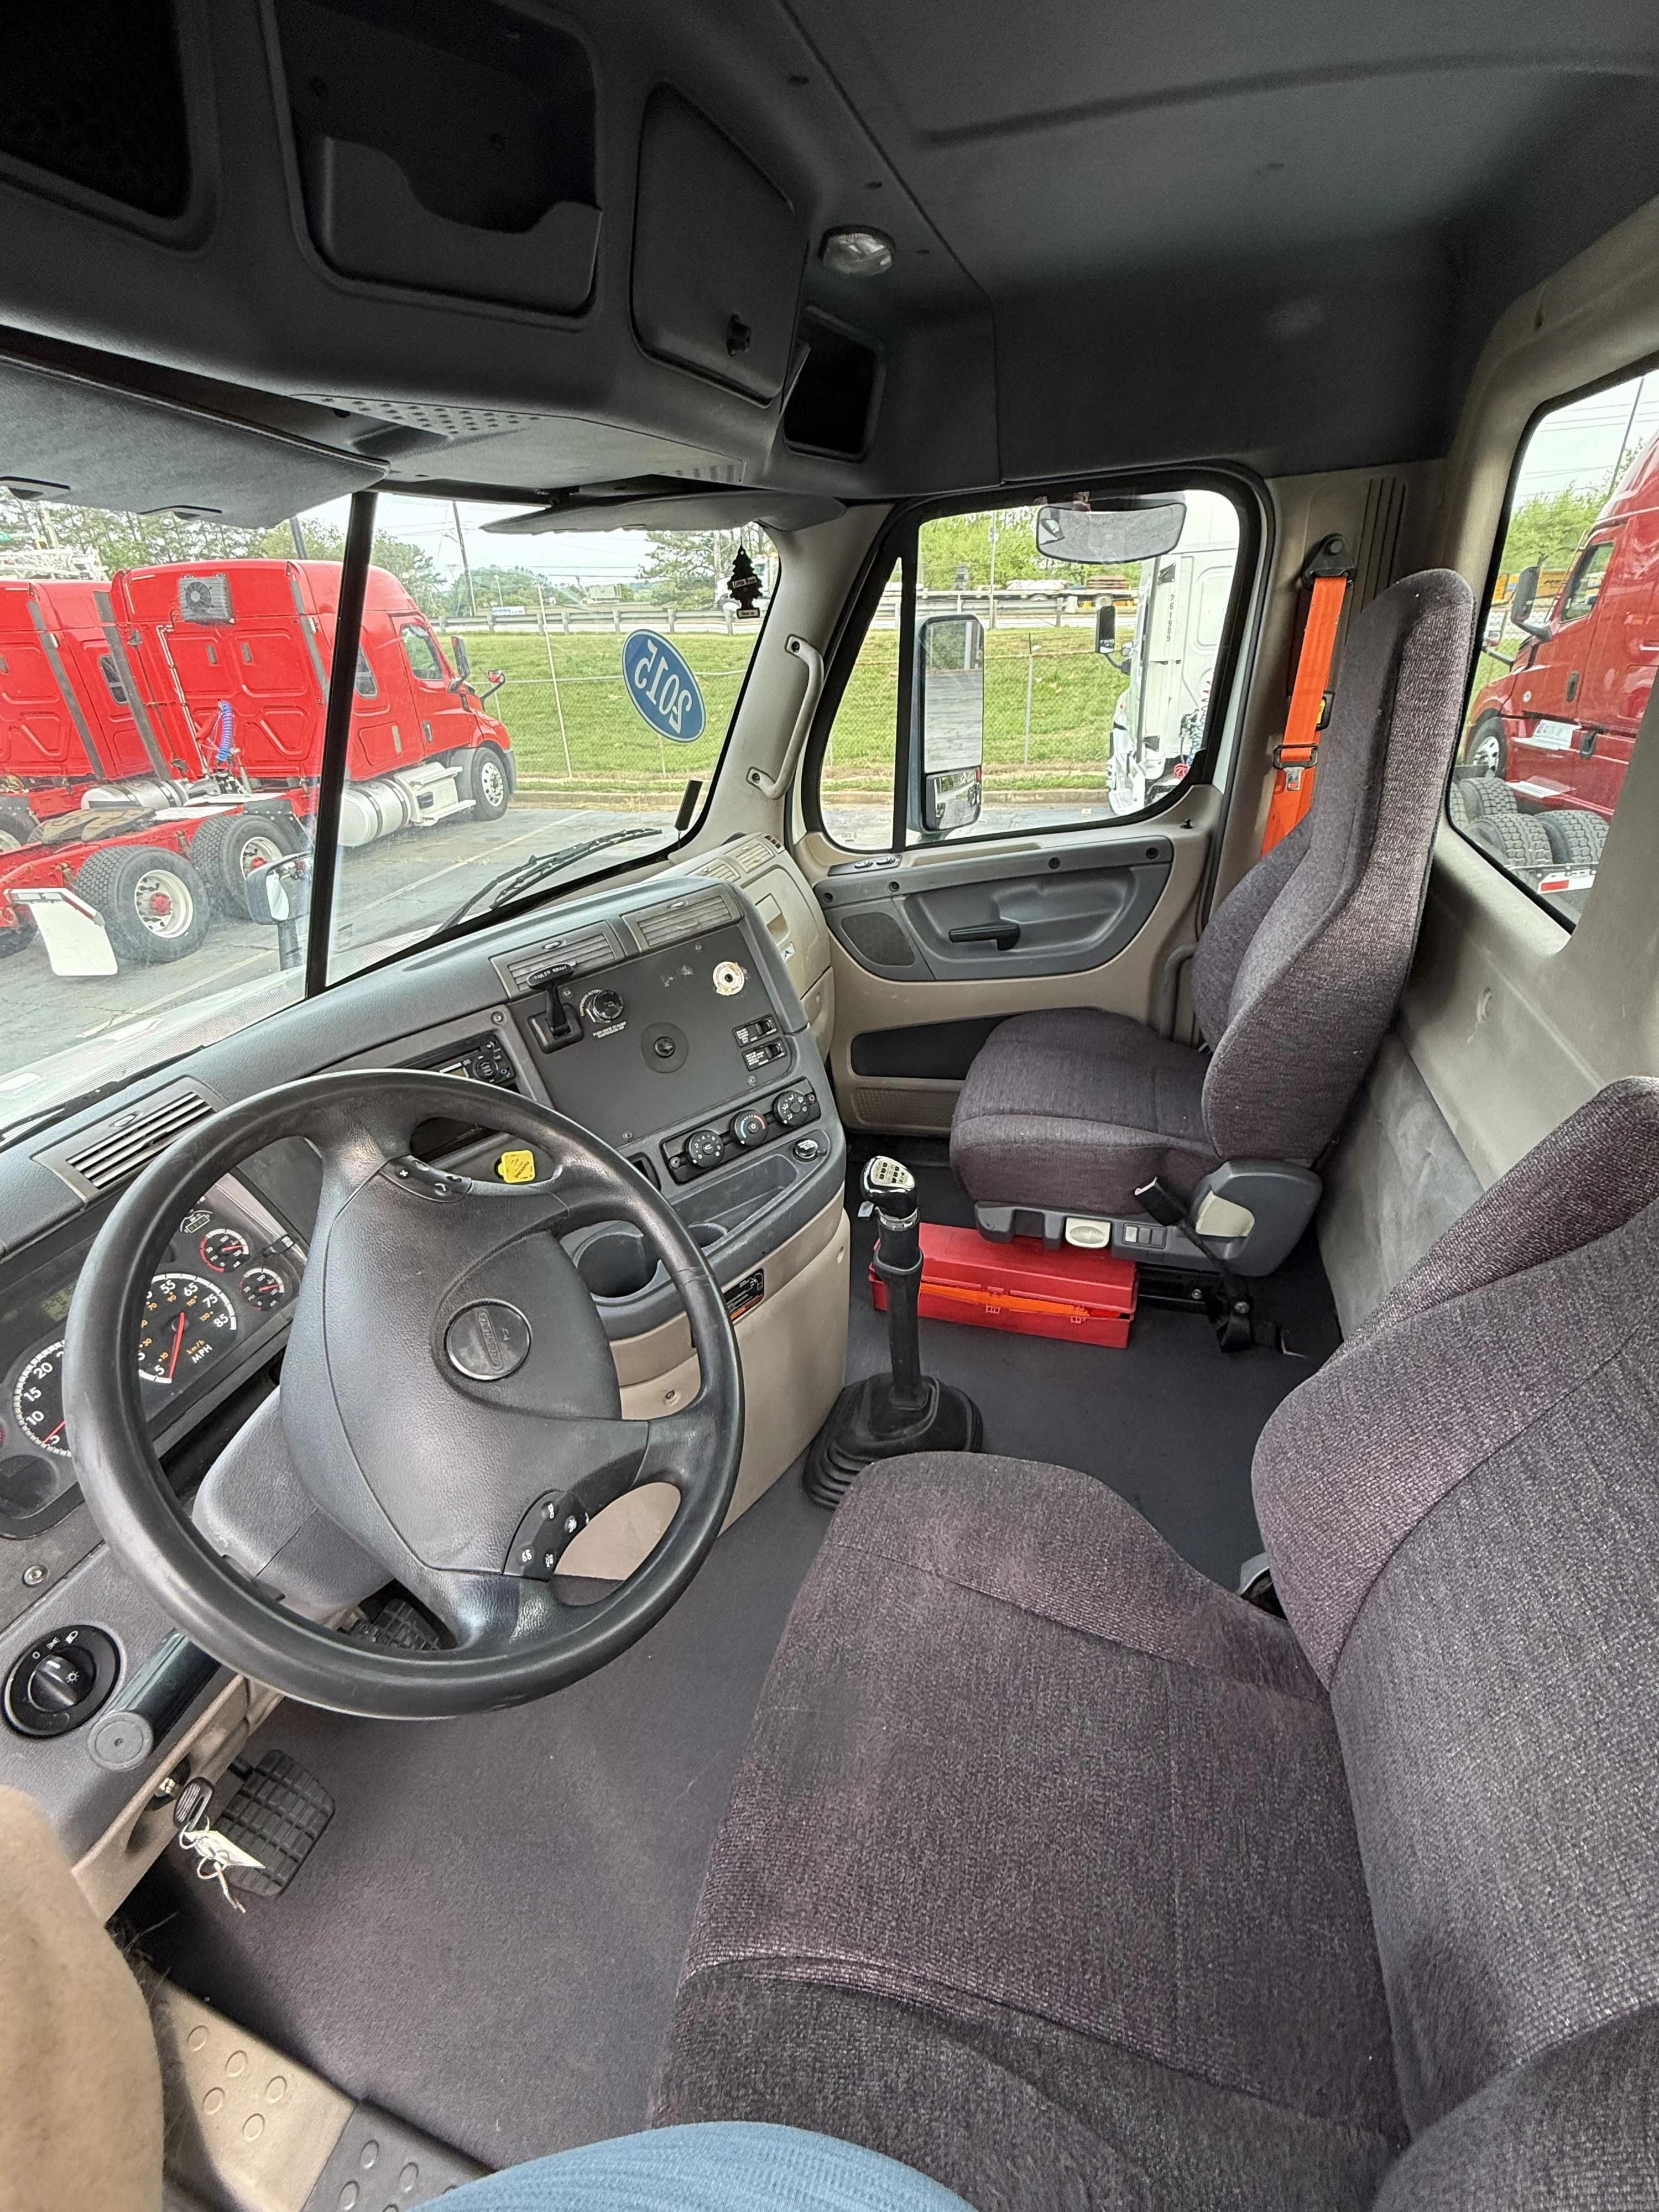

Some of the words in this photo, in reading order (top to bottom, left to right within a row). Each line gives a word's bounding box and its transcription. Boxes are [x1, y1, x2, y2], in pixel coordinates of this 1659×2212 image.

[1166, 594, 1175, 642] 261989
[160, 1279, 176, 1294] 55
[184, 1282, 198, 1297] 65
[202, 1293, 218, 1308] 75
[213, 1313, 229, 1328] 85
[143, 1338, 152, 1347] 30
[186, 1339, 205, 1355] km/h
[191, 1344, 213, 1364] MPH
[33, 1362, 53, 1379] 20
[154, 1364, 165, 1375] 5
[23, 1386, 41, 1402] 15
[26, 1411, 44, 1426] 10
